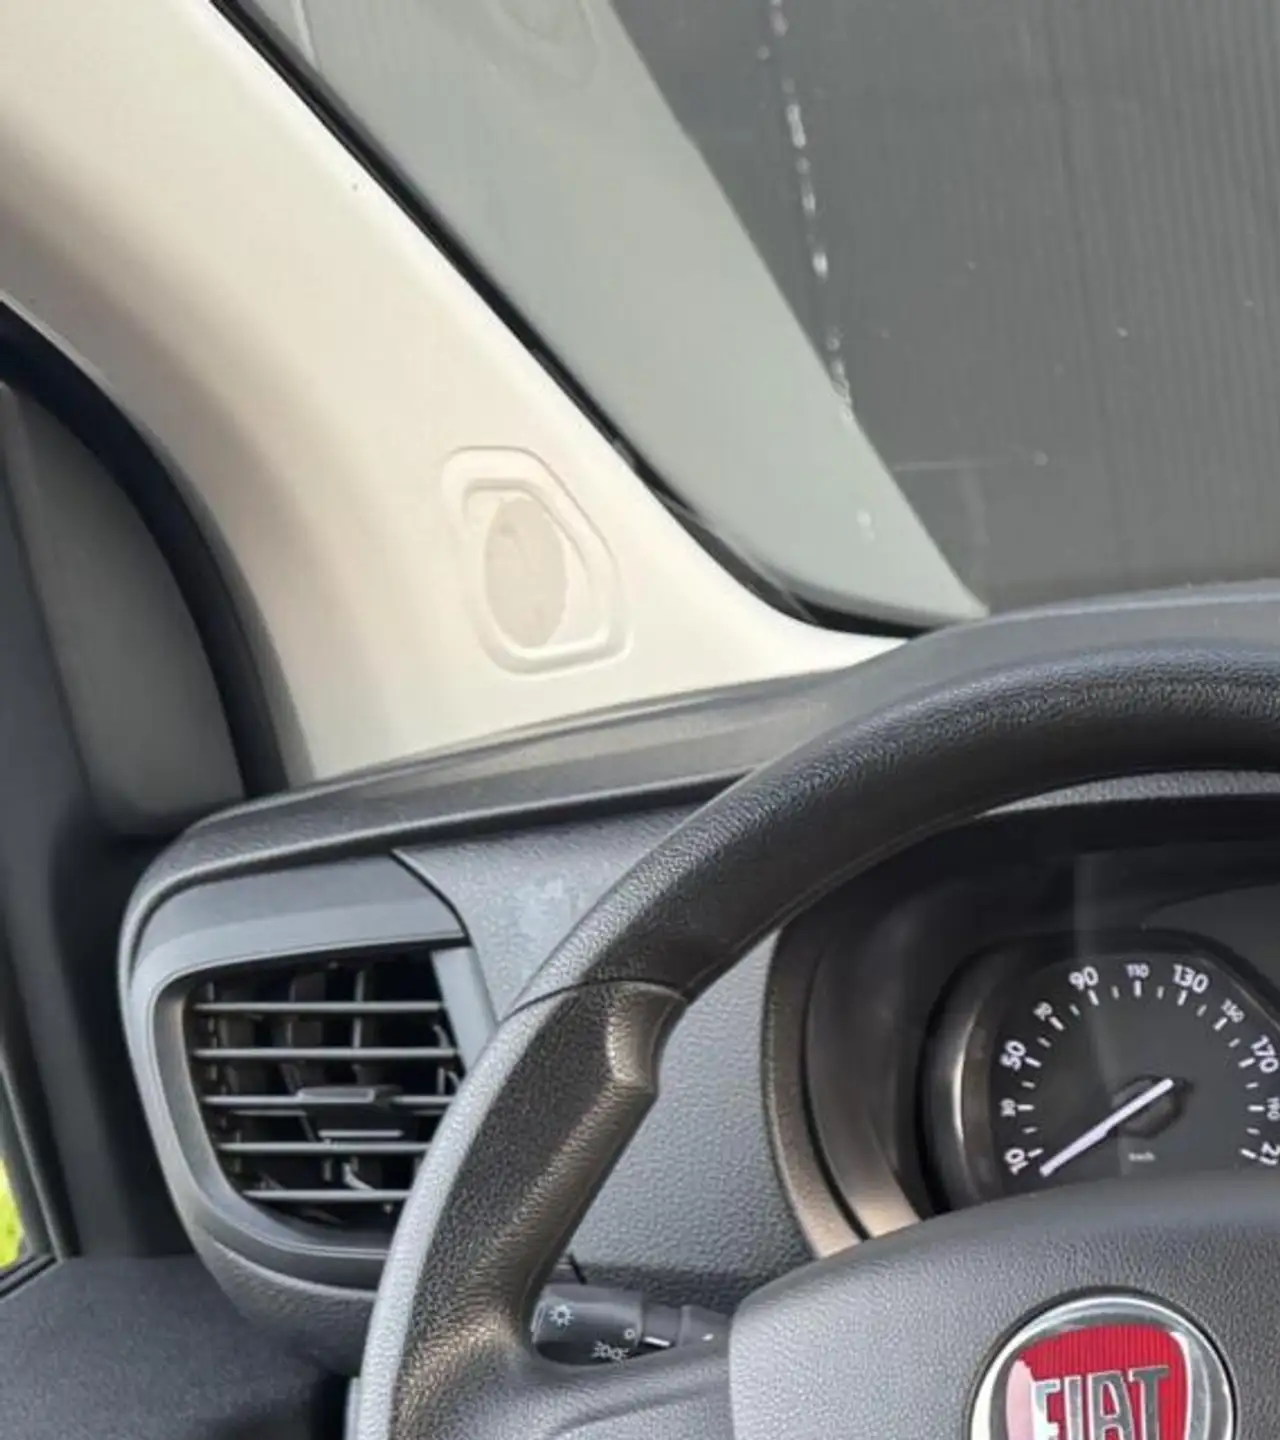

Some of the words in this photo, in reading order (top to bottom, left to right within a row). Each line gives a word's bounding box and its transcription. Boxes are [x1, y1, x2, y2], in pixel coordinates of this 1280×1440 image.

[1068, 966, 1099, 990] 90
[1125, 963, 1149, 979] 110
[1172, 963, 1209, 995] 130
[1000, 1040, 1027, 1071] 50
[1250, 1035, 1280, 1074] 170
[1003, 1147, 1028, 1176] 10
